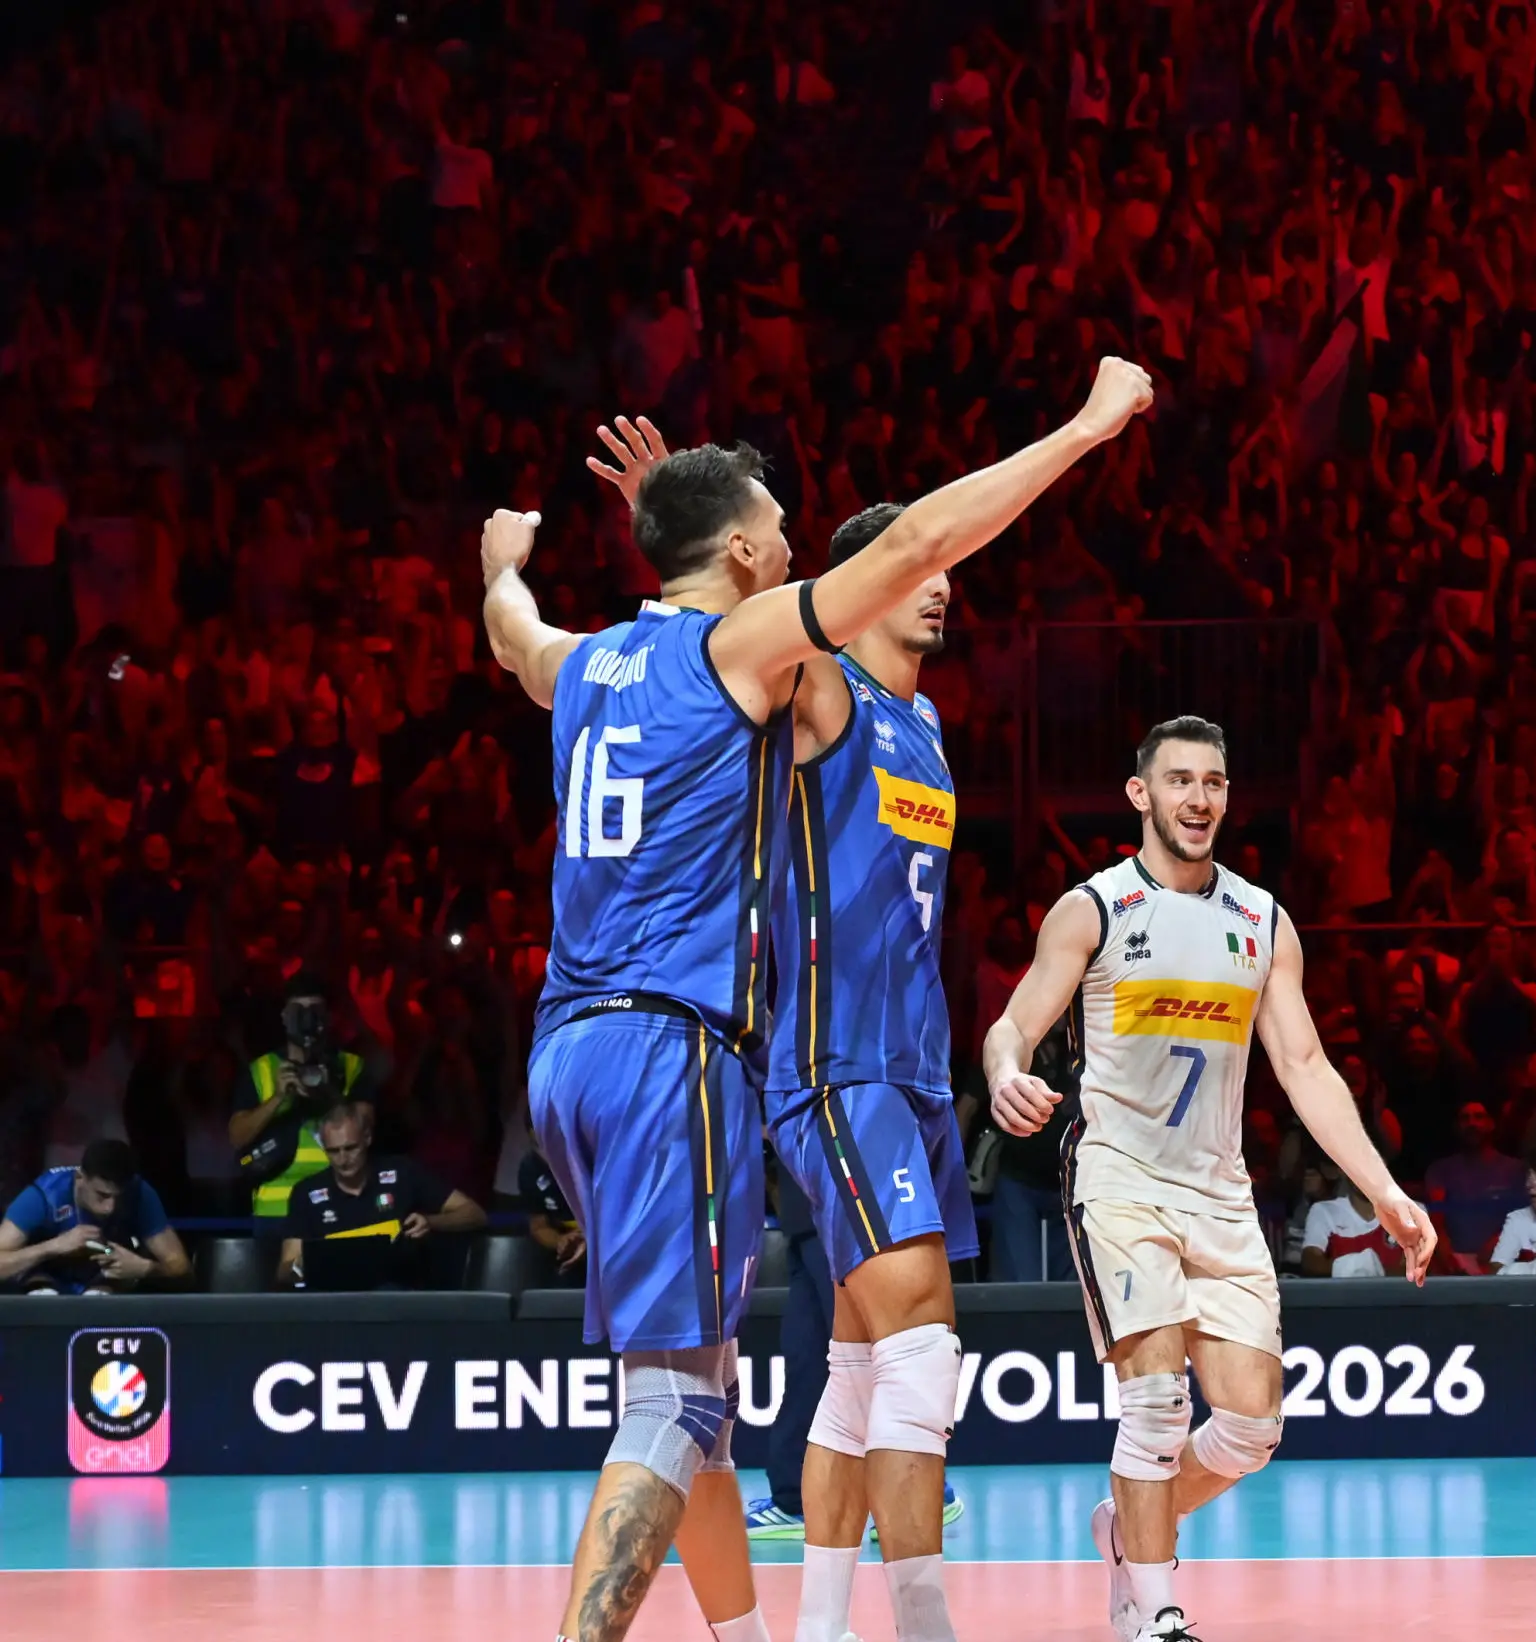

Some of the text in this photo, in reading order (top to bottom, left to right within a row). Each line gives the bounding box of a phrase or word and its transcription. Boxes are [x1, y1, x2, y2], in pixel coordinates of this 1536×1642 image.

[566, 724, 644, 858] 16
[895, 797, 948, 829] DHL
[1233, 954, 1257, 972] ITA
[1150, 998, 1233, 1023] DHL
[1165, 1044, 1207, 1128] 7
[892, 1167, 916, 1203] 5
[1115, 1269, 1132, 1301] 7
[97, 1338, 141, 1355] CEV
[253, 1361, 429, 1433] CEV
[455, 1359, 626, 1430] ENE
[1282, 1344, 1485, 1417] 2026
